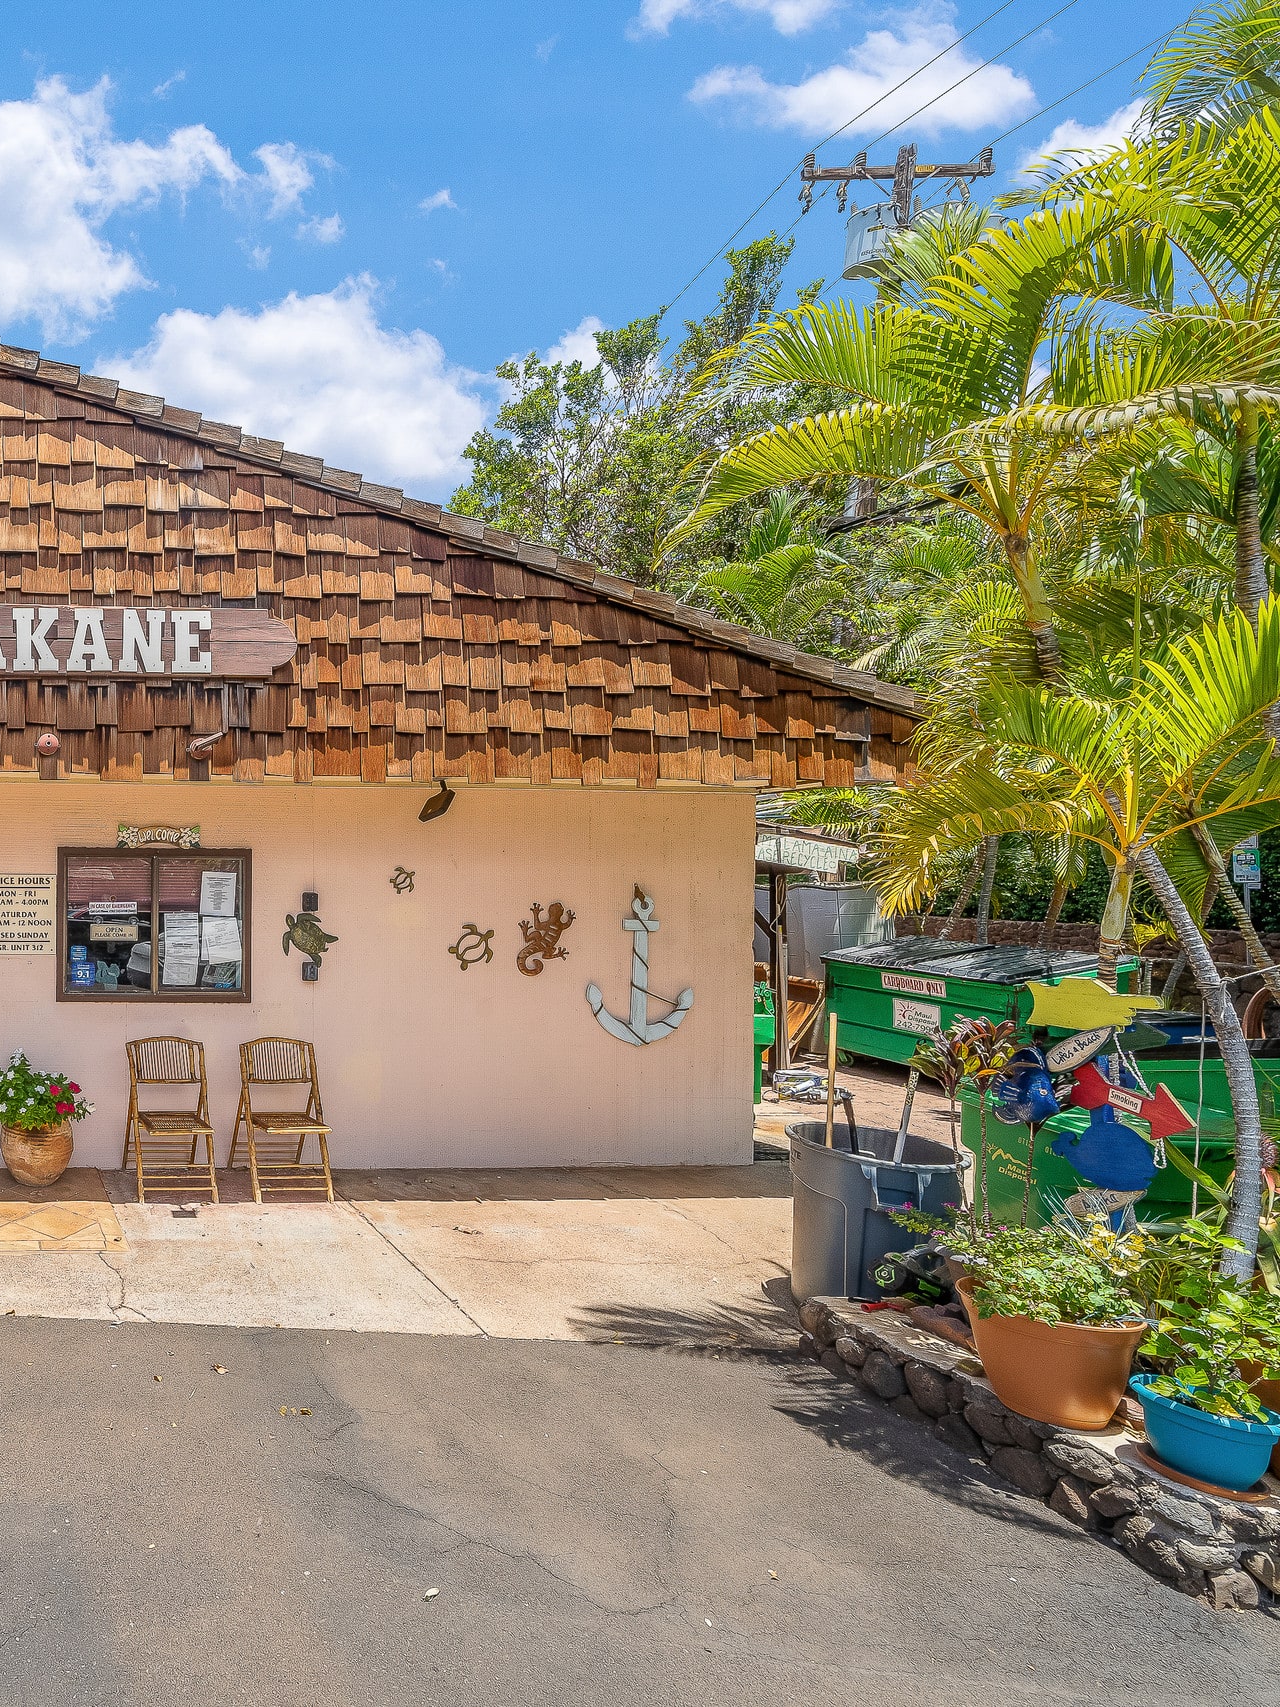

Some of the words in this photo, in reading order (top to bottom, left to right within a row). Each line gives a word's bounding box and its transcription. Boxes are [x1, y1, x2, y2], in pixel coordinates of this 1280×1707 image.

[782, 850, 829, 871] RECYCLE
[18, 877, 51, 885] HOURS
[77, 970, 90, 978] 9.1
[883, 975, 924, 992] CARDBOARD
[926, 981, 944, 995] ONLY
[907, 1014, 938, 1026] Disposal
[914, 1011, 933, 1020] Maui
[1074, 1031, 1101, 1051] Beach
[1110, 1090, 1139, 1111] Smoking
[1007, 1163, 1029, 1176] Mau
